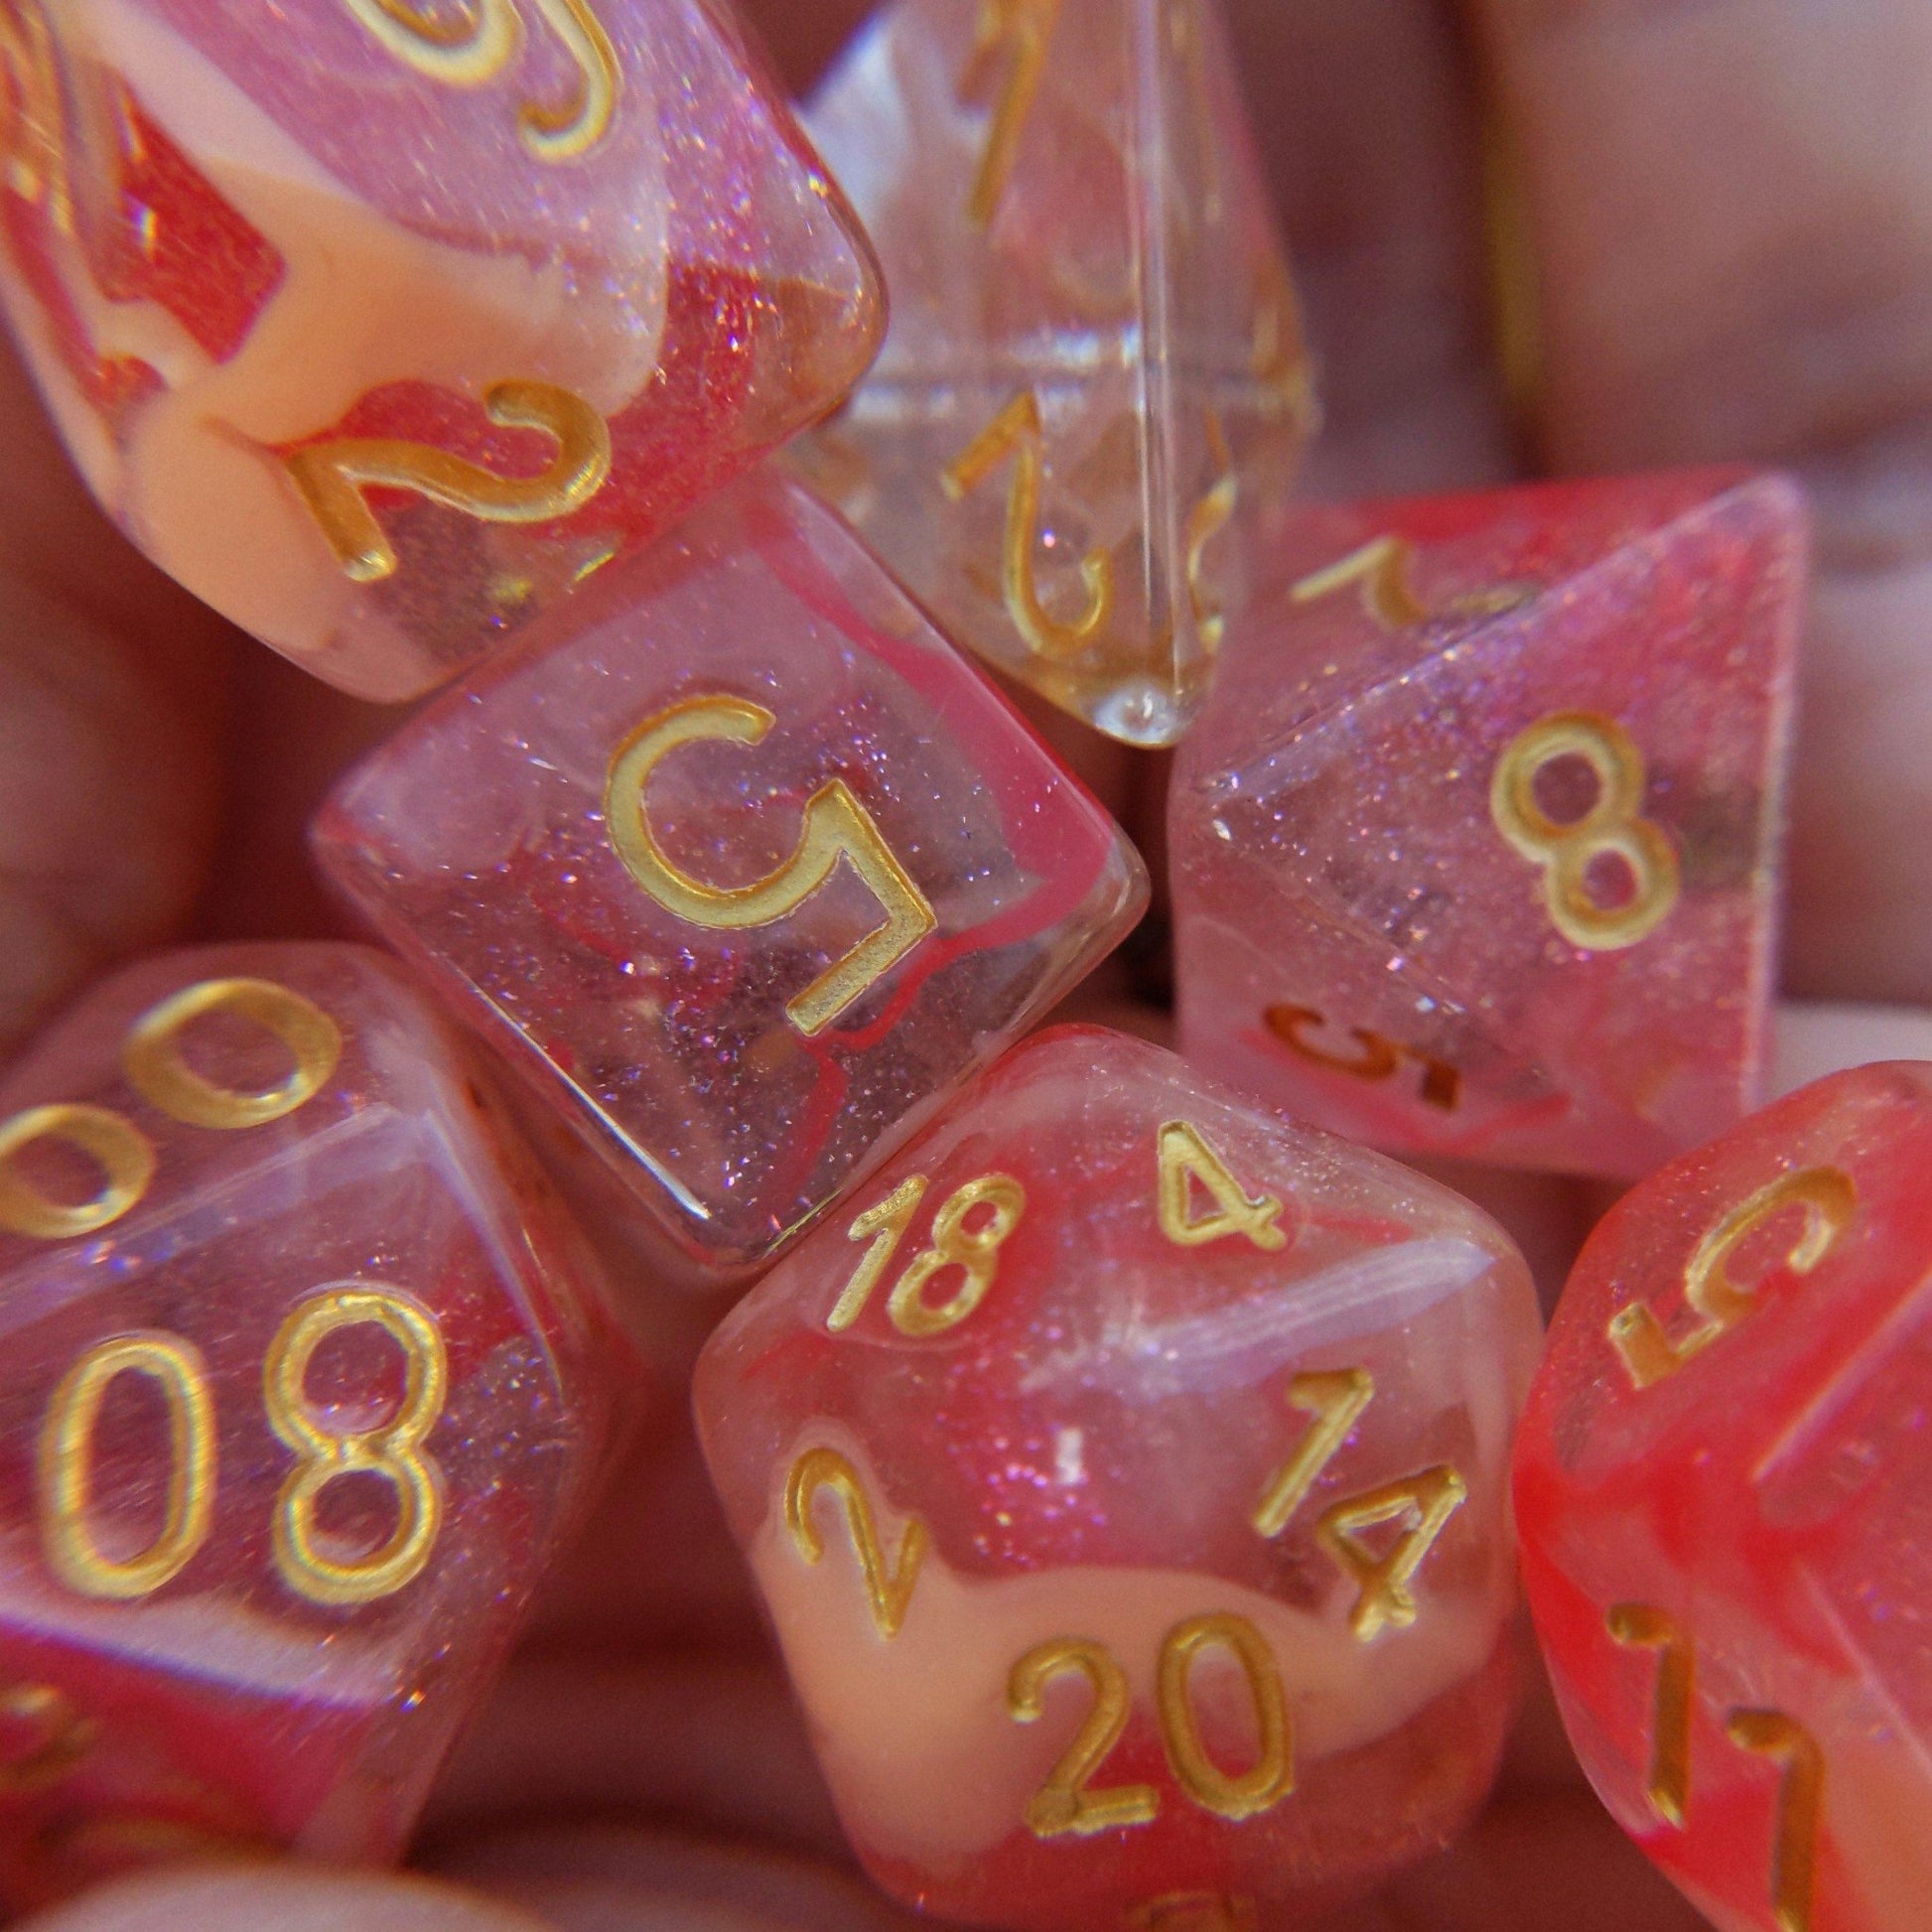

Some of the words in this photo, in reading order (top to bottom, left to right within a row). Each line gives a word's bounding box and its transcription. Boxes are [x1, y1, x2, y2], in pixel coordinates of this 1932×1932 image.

[603, 695, 938, 1036] 5
[1491, 709, 1680, 951] 8
[1263, 1004, 1463, 1113] 5
[826, 1172, 1026, 1337] 18
[1156, 1119, 1287, 1252] 4
[1608, 1166, 1857, 1388] 5
[784, 1446, 929, 1644] 2
[1252, 1366, 1469, 1644] 14
[1007, 1610, 1297, 1839] 20
